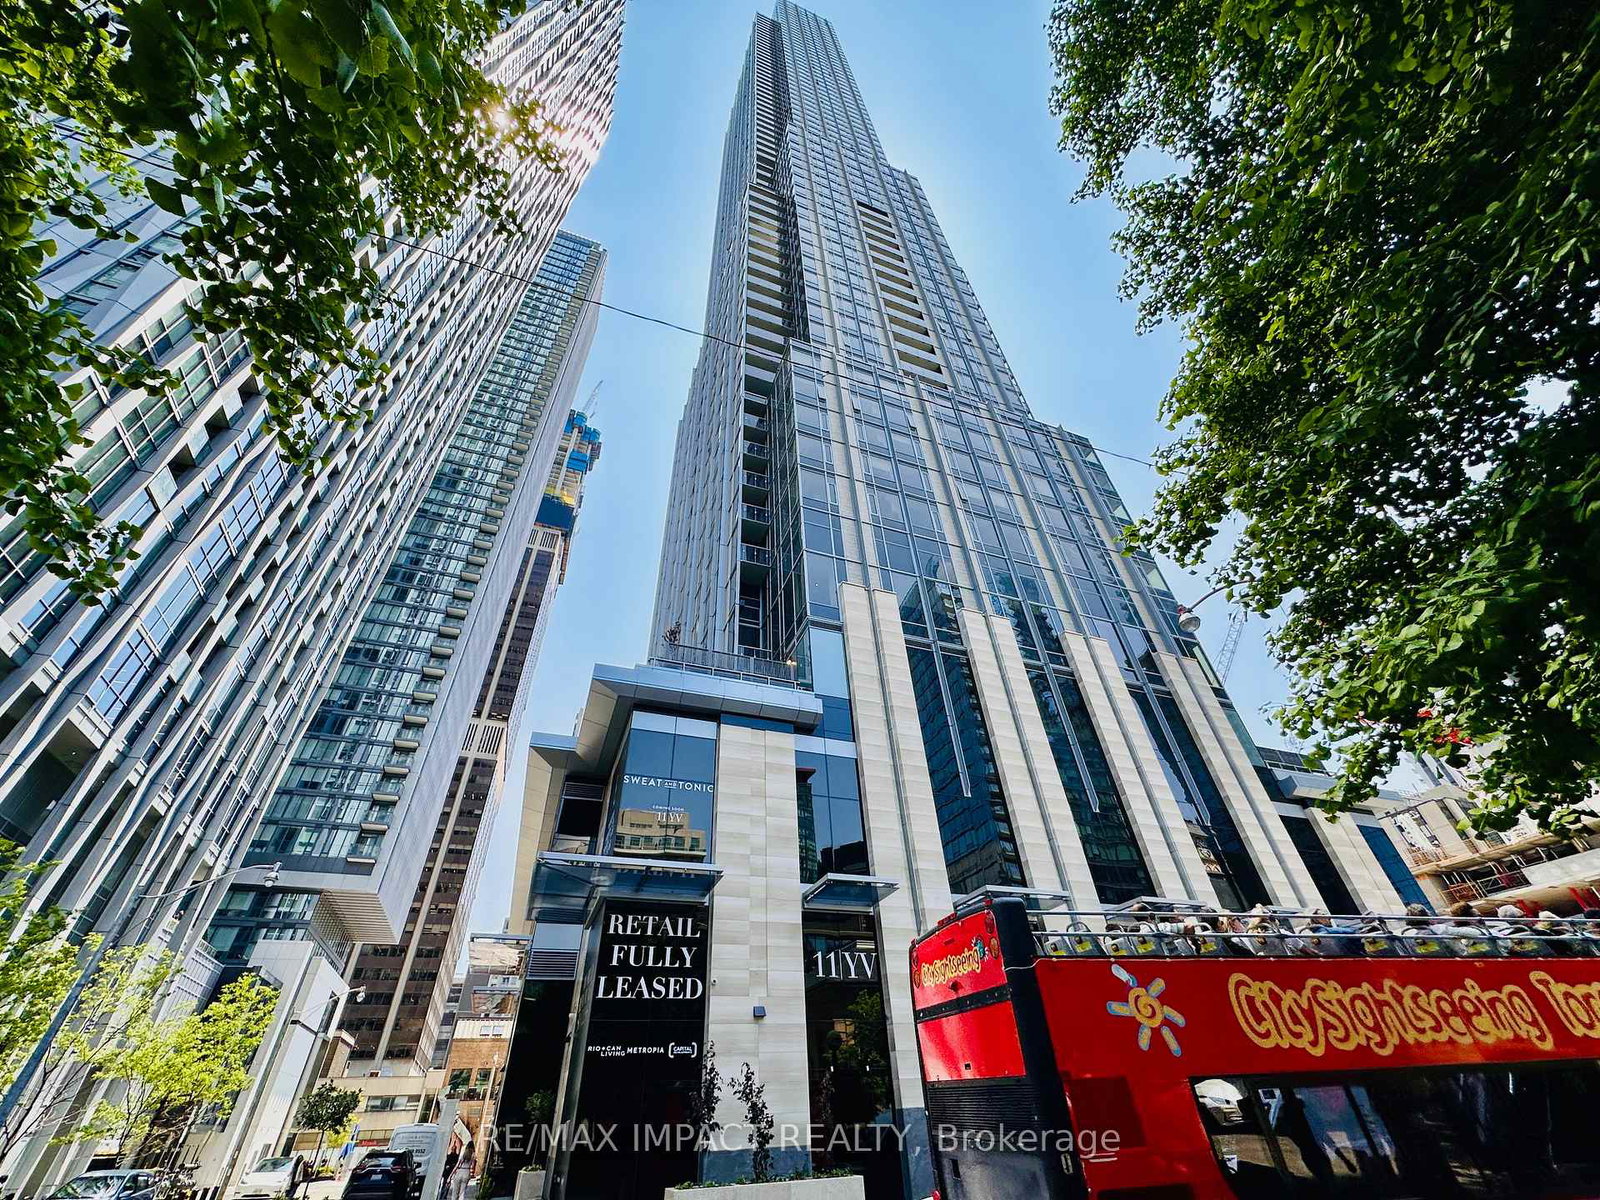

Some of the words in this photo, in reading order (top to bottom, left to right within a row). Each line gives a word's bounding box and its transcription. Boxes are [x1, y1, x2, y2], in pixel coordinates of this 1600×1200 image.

[623, 774, 663, 788] SWEAT
[678, 781, 714, 793] TONIC
[607, 913, 701, 938] RETAIL
[609, 944, 698, 968] FULLY
[595, 975, 704, 1000] LEASED
[626, 1046, 665, 1054] METROPIA
